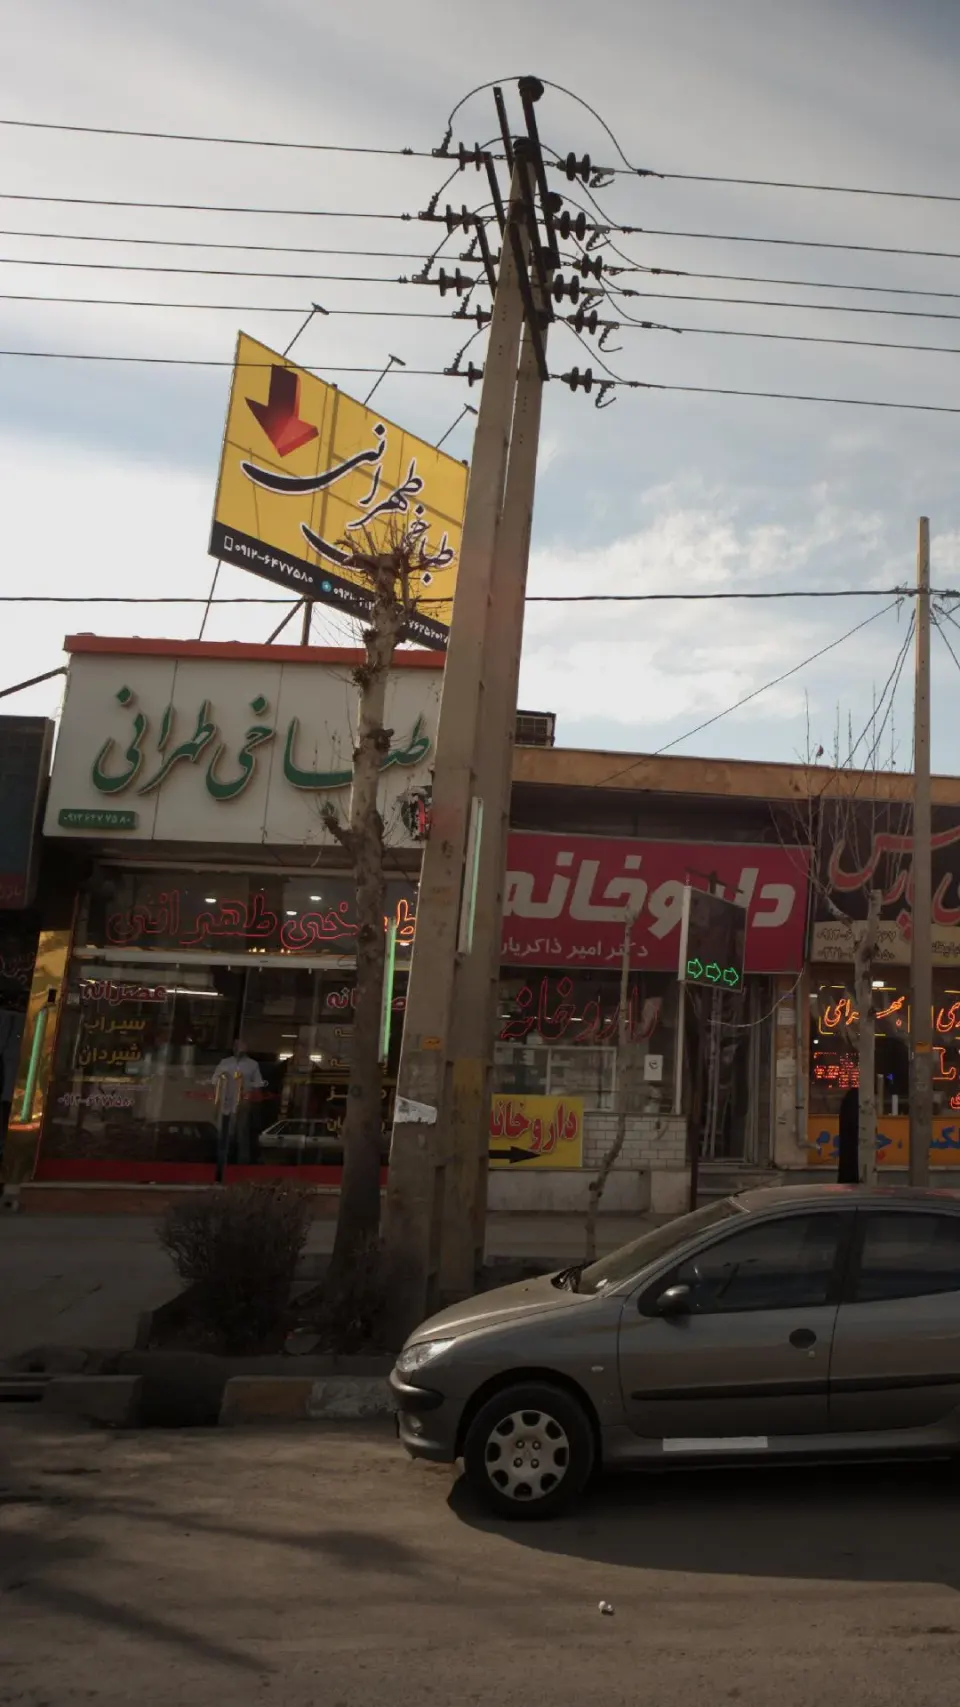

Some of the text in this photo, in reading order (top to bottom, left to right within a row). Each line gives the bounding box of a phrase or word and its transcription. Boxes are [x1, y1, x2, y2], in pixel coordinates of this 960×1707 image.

[240, 423, 424, 530] طهرانی
[92, 685, 216, 794] طهرانی
[105, 889, 279, 945] طهرانی
[566, 941, 602, 960] امیر
